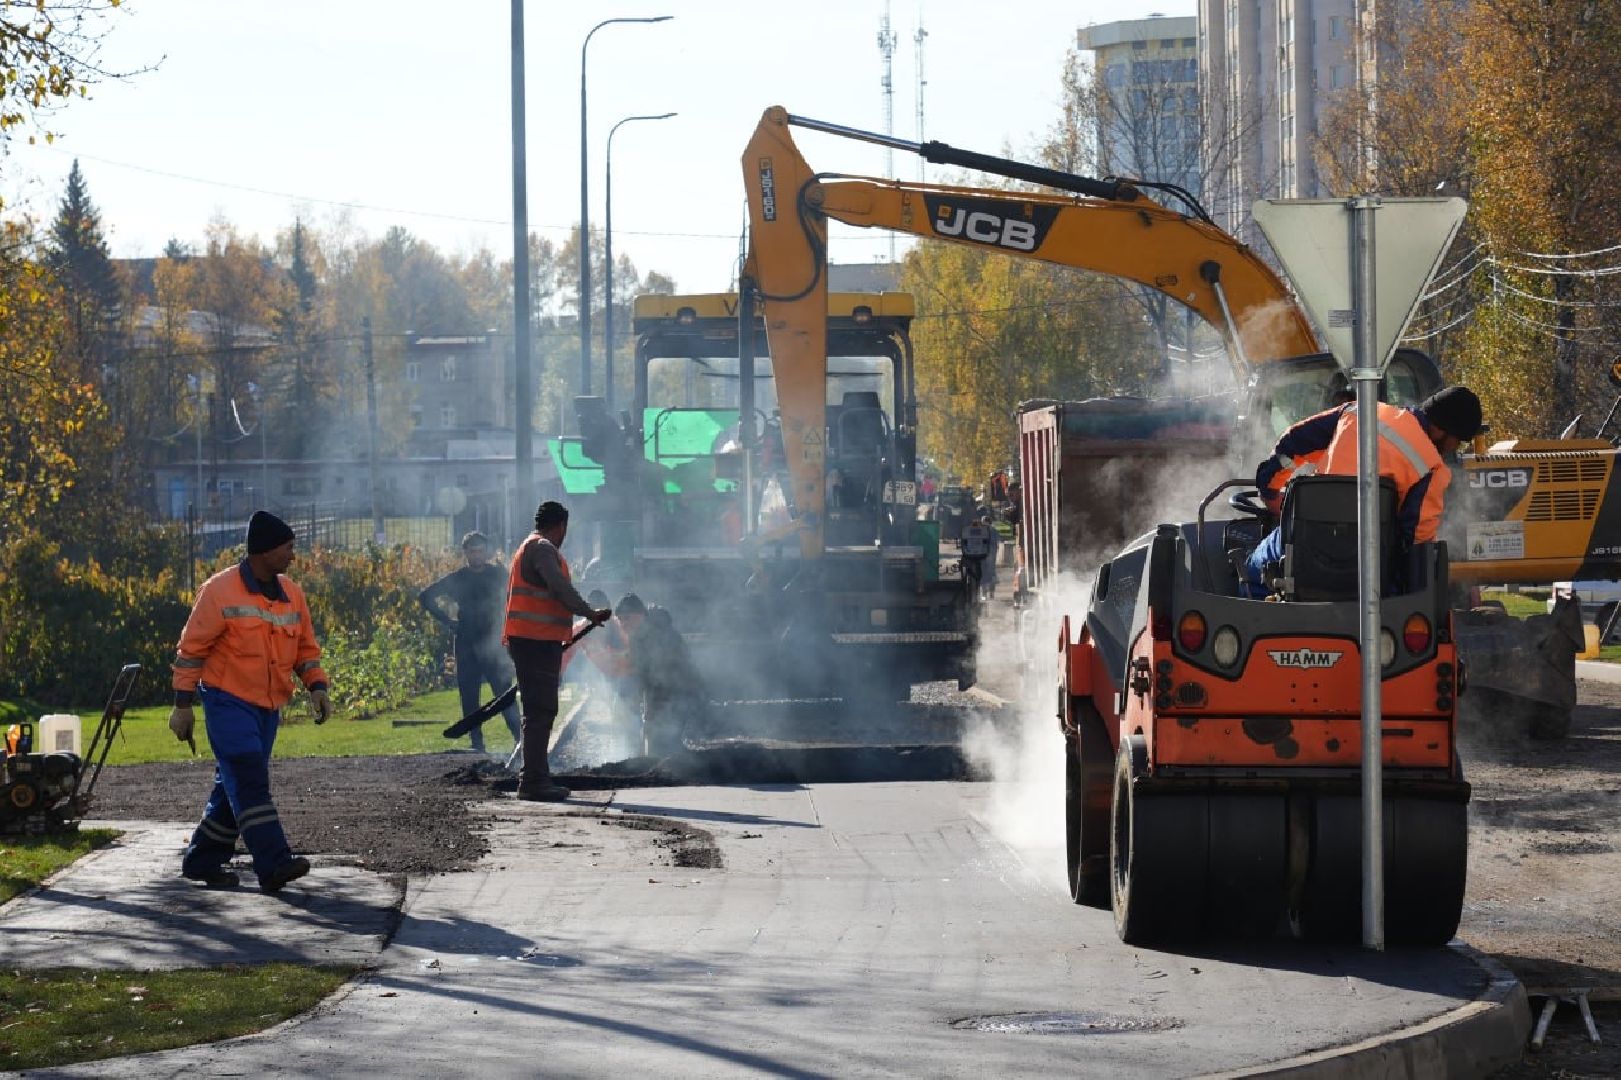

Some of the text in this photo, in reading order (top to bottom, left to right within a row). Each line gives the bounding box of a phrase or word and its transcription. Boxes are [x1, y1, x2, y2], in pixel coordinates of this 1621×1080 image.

[936, 209, 1036, 250] JCB
[1469, 469, 1528, 488] JCB
[1280, 652, 1330, 665] HAMM
